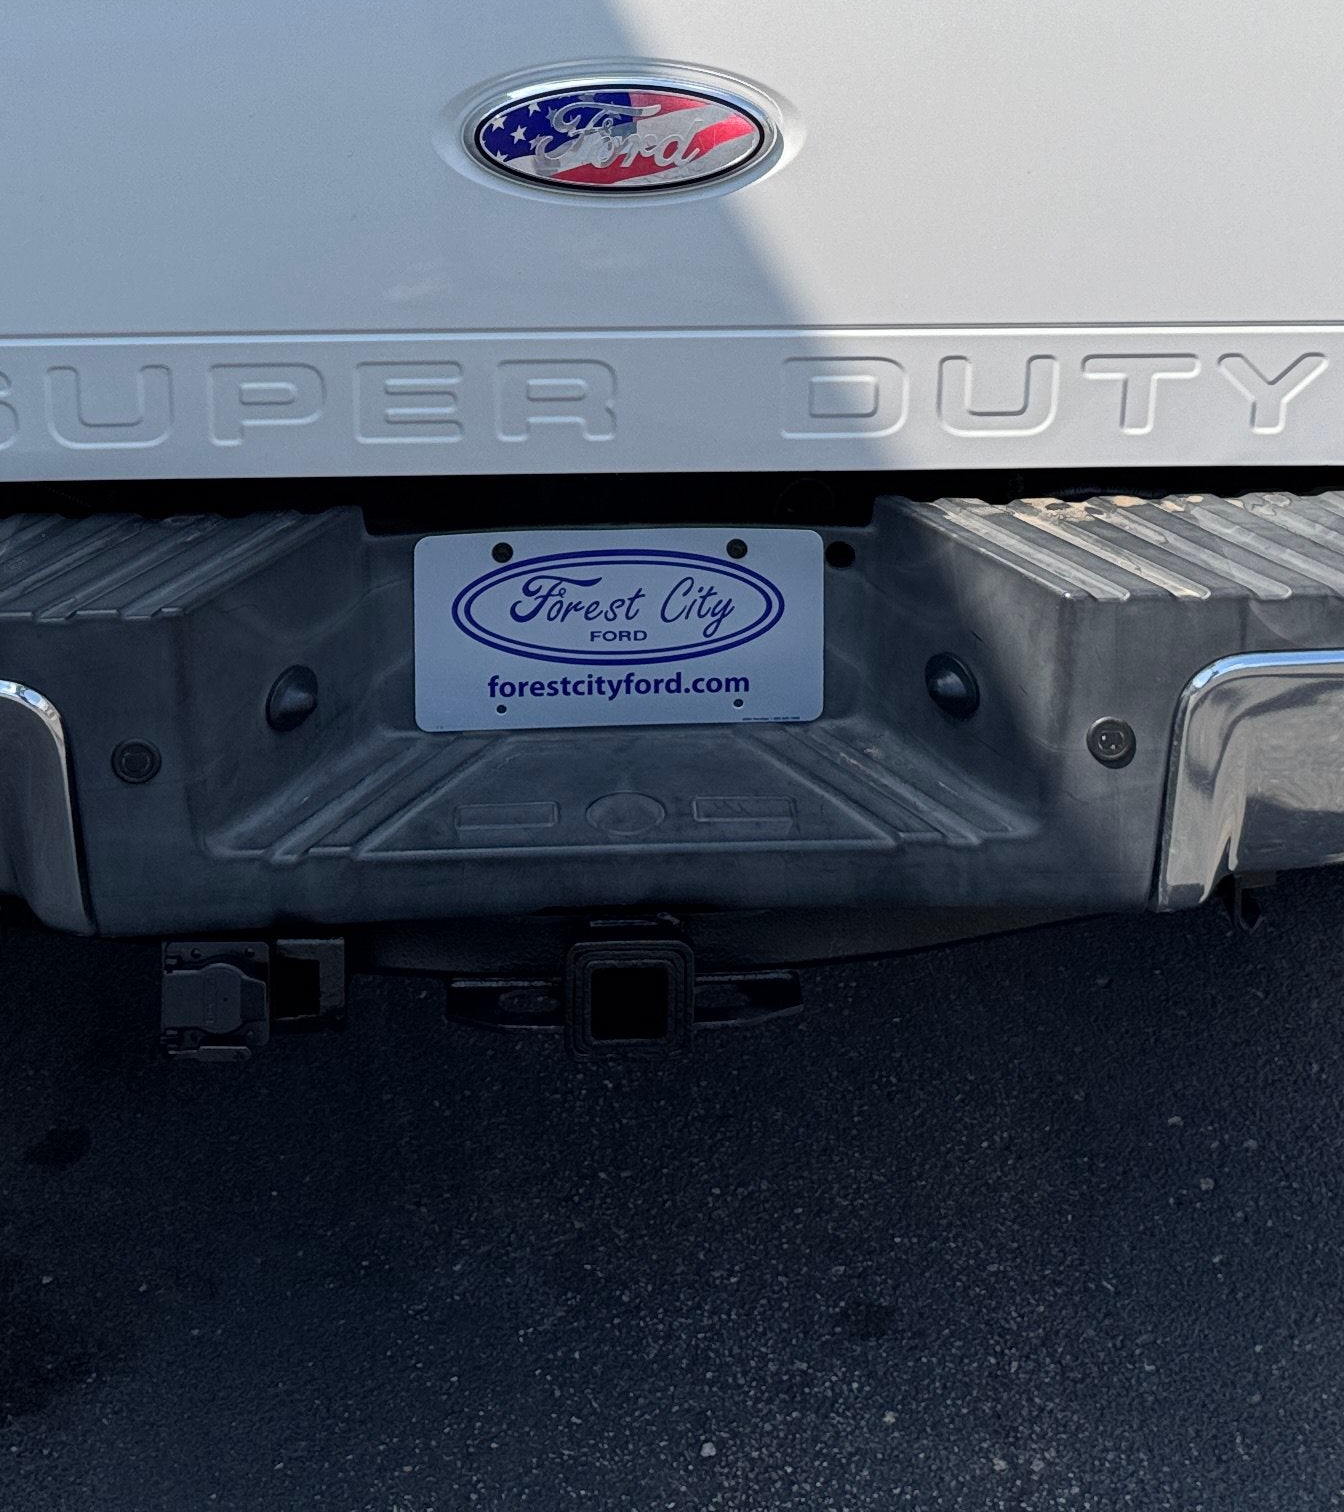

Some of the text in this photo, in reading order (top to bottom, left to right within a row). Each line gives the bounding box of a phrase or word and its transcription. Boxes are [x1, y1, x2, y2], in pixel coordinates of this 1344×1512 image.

[534, 101, 704, 169] Ford
[780, 351, 1329, 440] DUTY
[509, 574, 736, 639] Forest City
[589, 630, 648, 643] FORD
[487, 671, 751, 702] forestcityford.com
